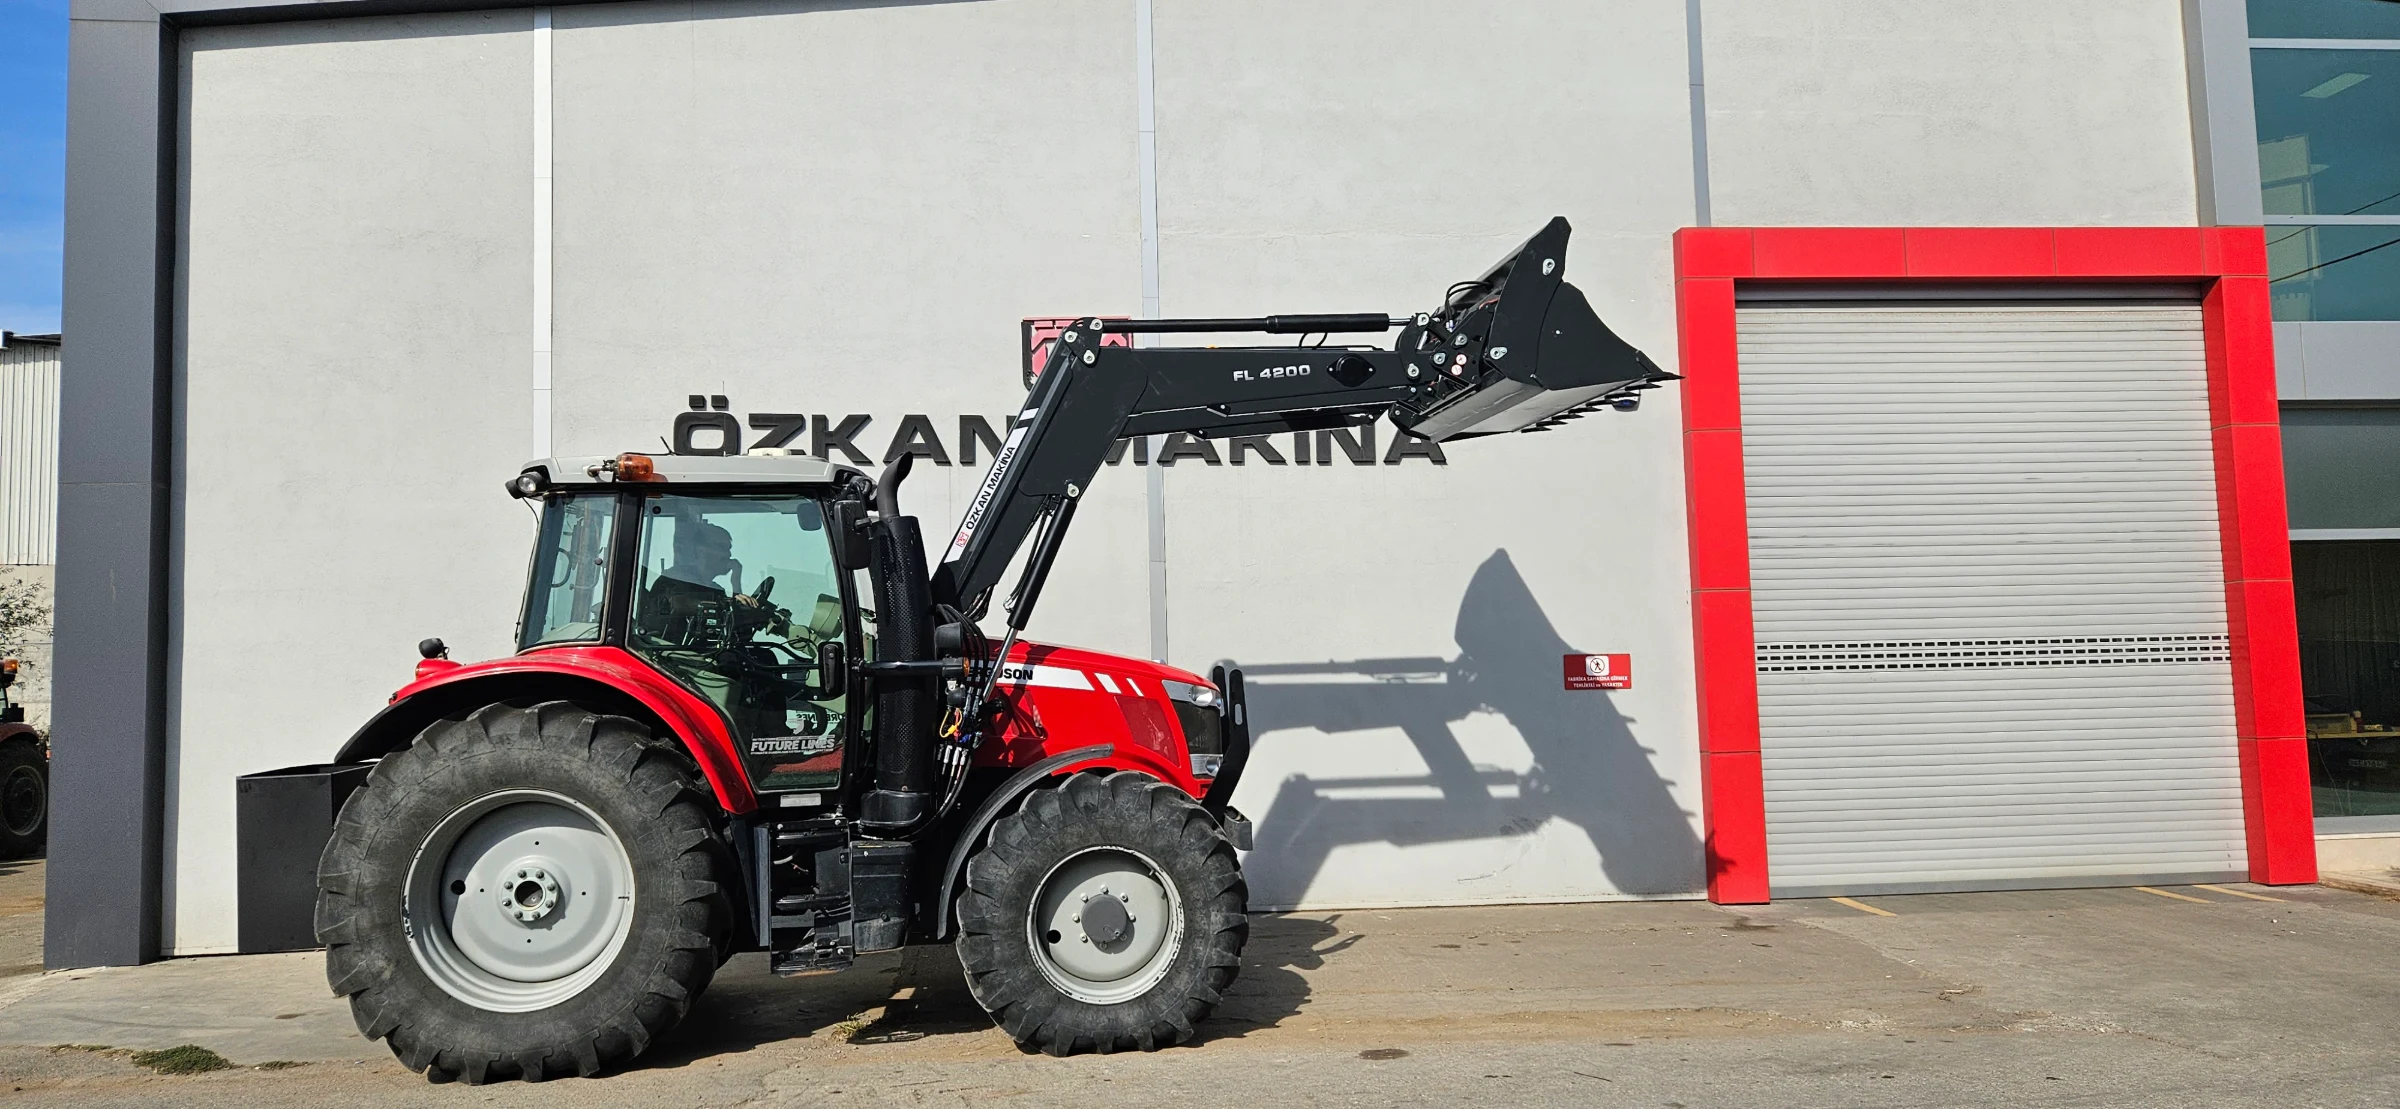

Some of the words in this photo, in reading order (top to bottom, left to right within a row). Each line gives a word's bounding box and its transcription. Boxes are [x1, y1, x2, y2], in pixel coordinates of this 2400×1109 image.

[1233, 370, 1254, 381] FL
[1260, 364, 1311, 379] 4200
[673, 394, 1016, 467] ÖZKAN
[965, 490, 991, 530] ÖZKAN
[987, 446, 1016, 490] MAKİNA
[751, 740, 800, 752] FUTURE
[801, 739, 835, 750] LINES
